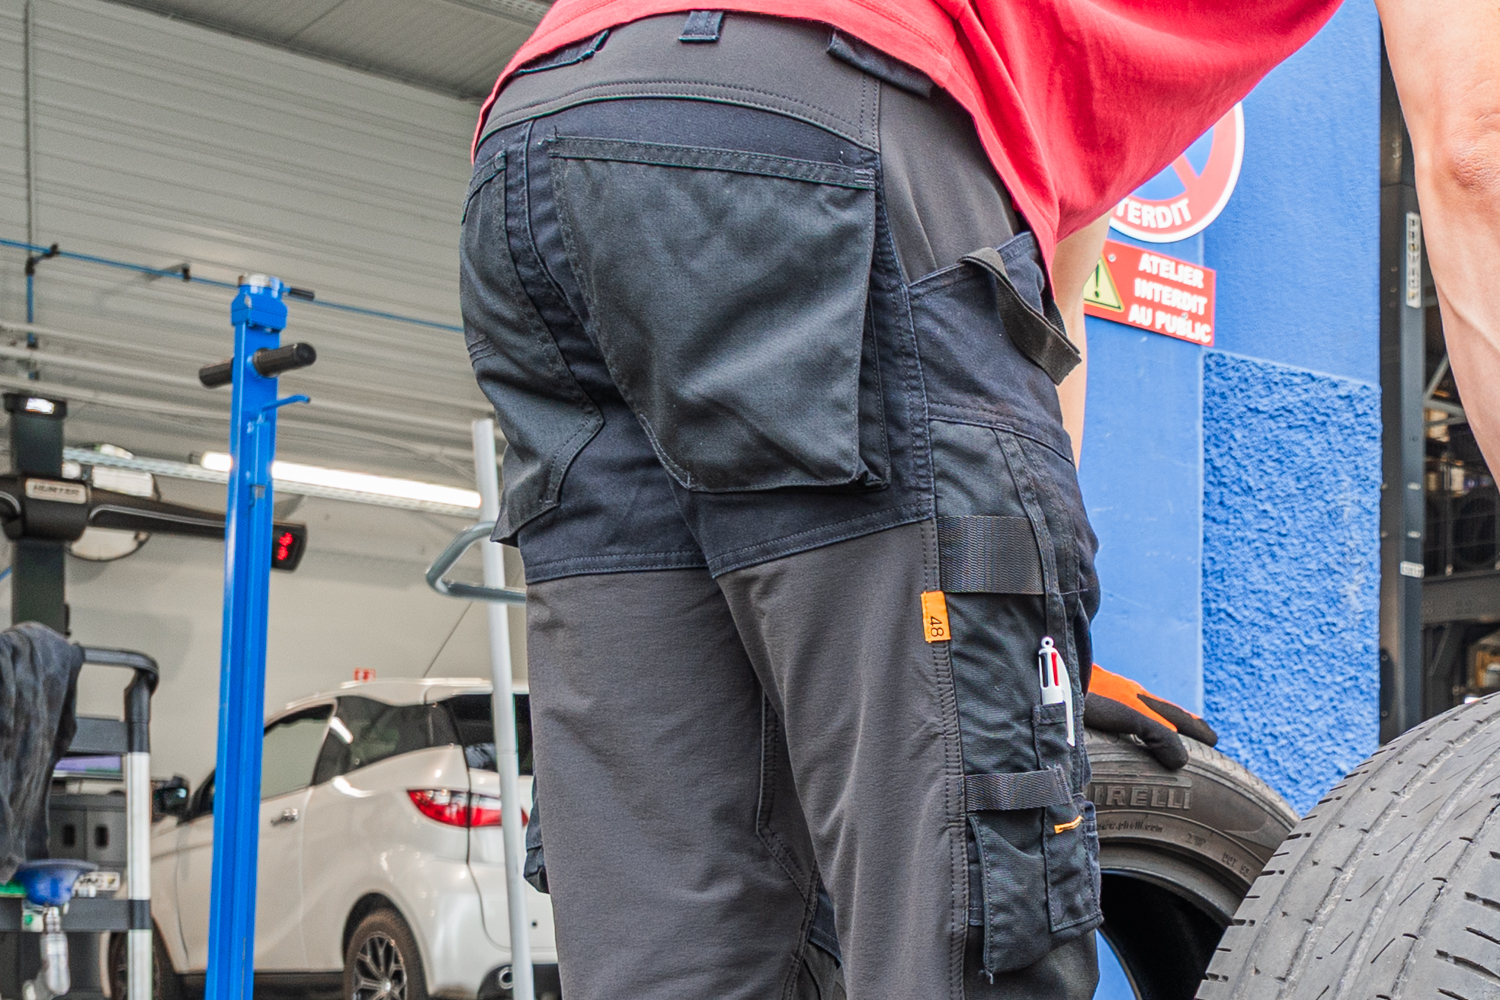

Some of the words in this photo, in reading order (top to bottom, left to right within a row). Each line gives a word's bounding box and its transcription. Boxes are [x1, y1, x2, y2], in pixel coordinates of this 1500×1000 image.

[1115, 197, 1192, 228] TERDIT
[1138, 253, 1204, 289] ATELIER
[1134, 277, 1208, 315] INTERDIT
[1127, 303, 1153, 327] AU
[1155, 310, 1212, 343] PUBLIC
[33, 484, 80, 496] HUNTER
[929, 615, 945, 638] 48
